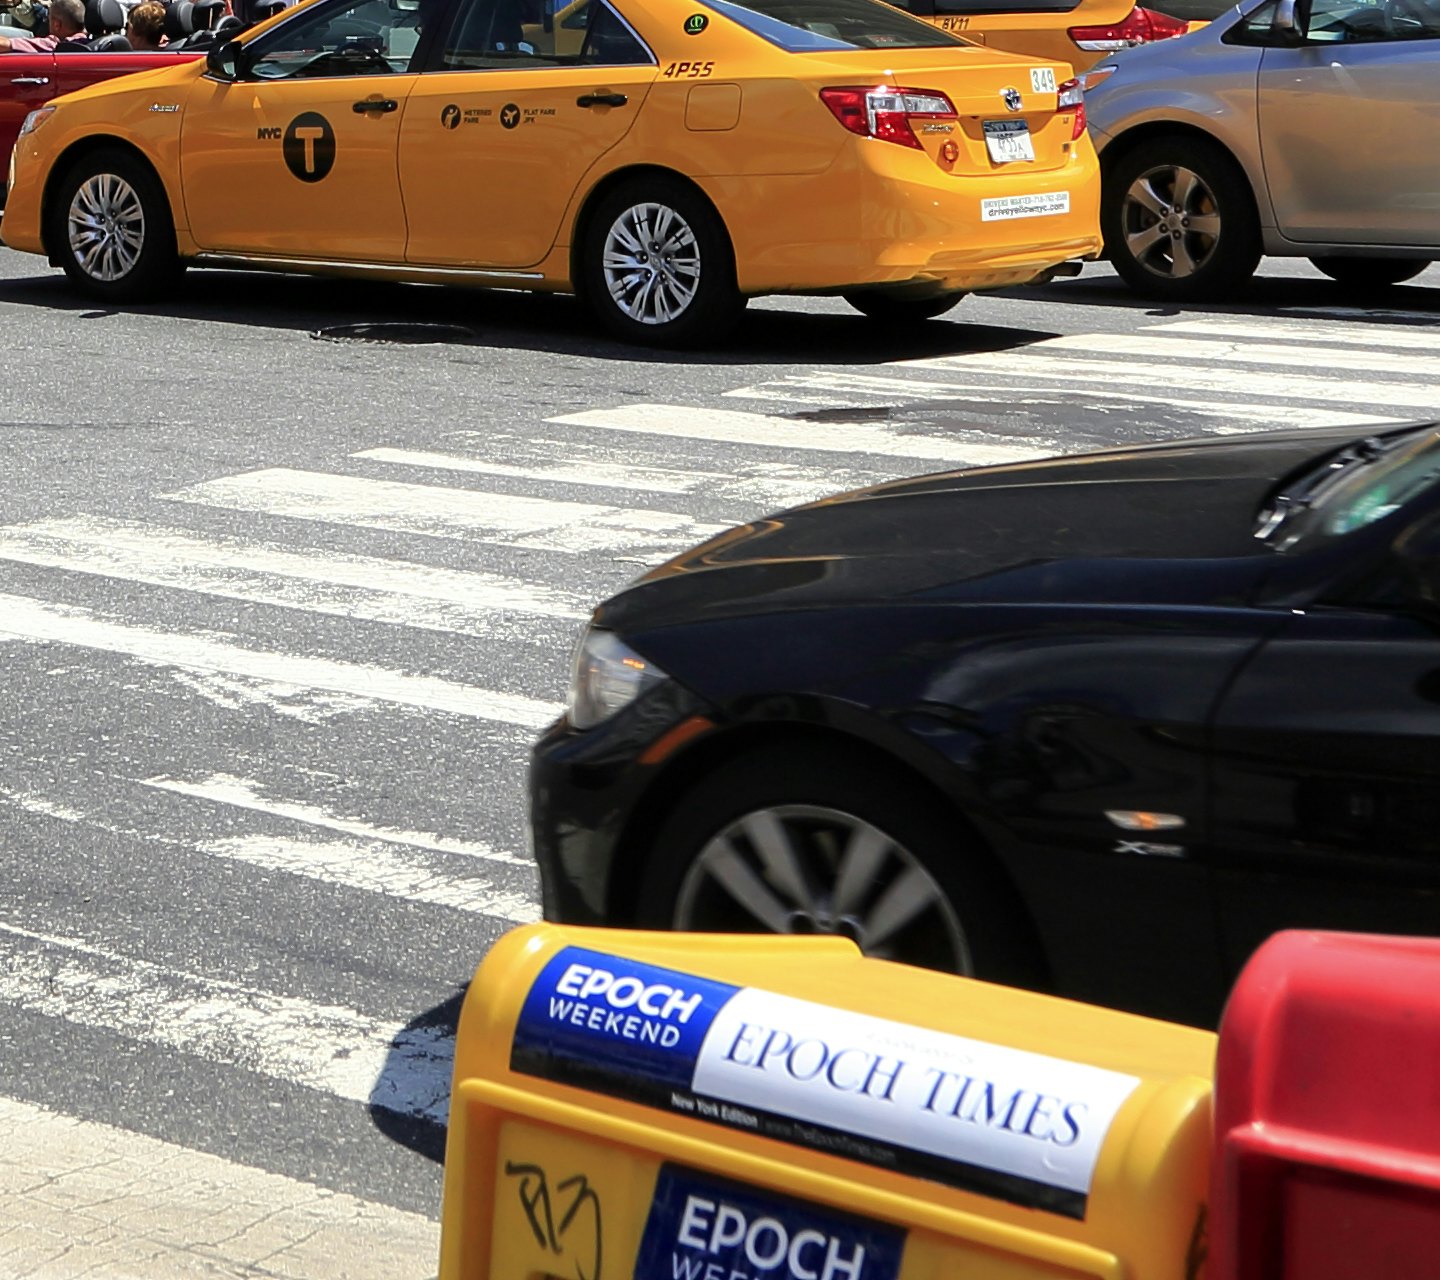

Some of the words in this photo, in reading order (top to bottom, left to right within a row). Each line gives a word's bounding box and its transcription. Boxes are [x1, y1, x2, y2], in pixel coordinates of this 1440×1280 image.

[663, 61, 715, 78] 4P55
[1032, 70, 1055, 91] 349
[257, 127, 281, 140] NYC
[295, 127, 323, 173] T
[556, 964, 703, 1024] EPOCH
[548, 997, 681, 1049] WEEKEND
[723, 1022, 903, 1102] EPOCH
[921, 1066, 1090, 1147] TIMES
[671, 1092, 693, 1109] New
[695, 1096, 722, 1118] York
[722, 1103, 758, 1127] Edition
[677, 1194, 865, 1280] EPOCH
